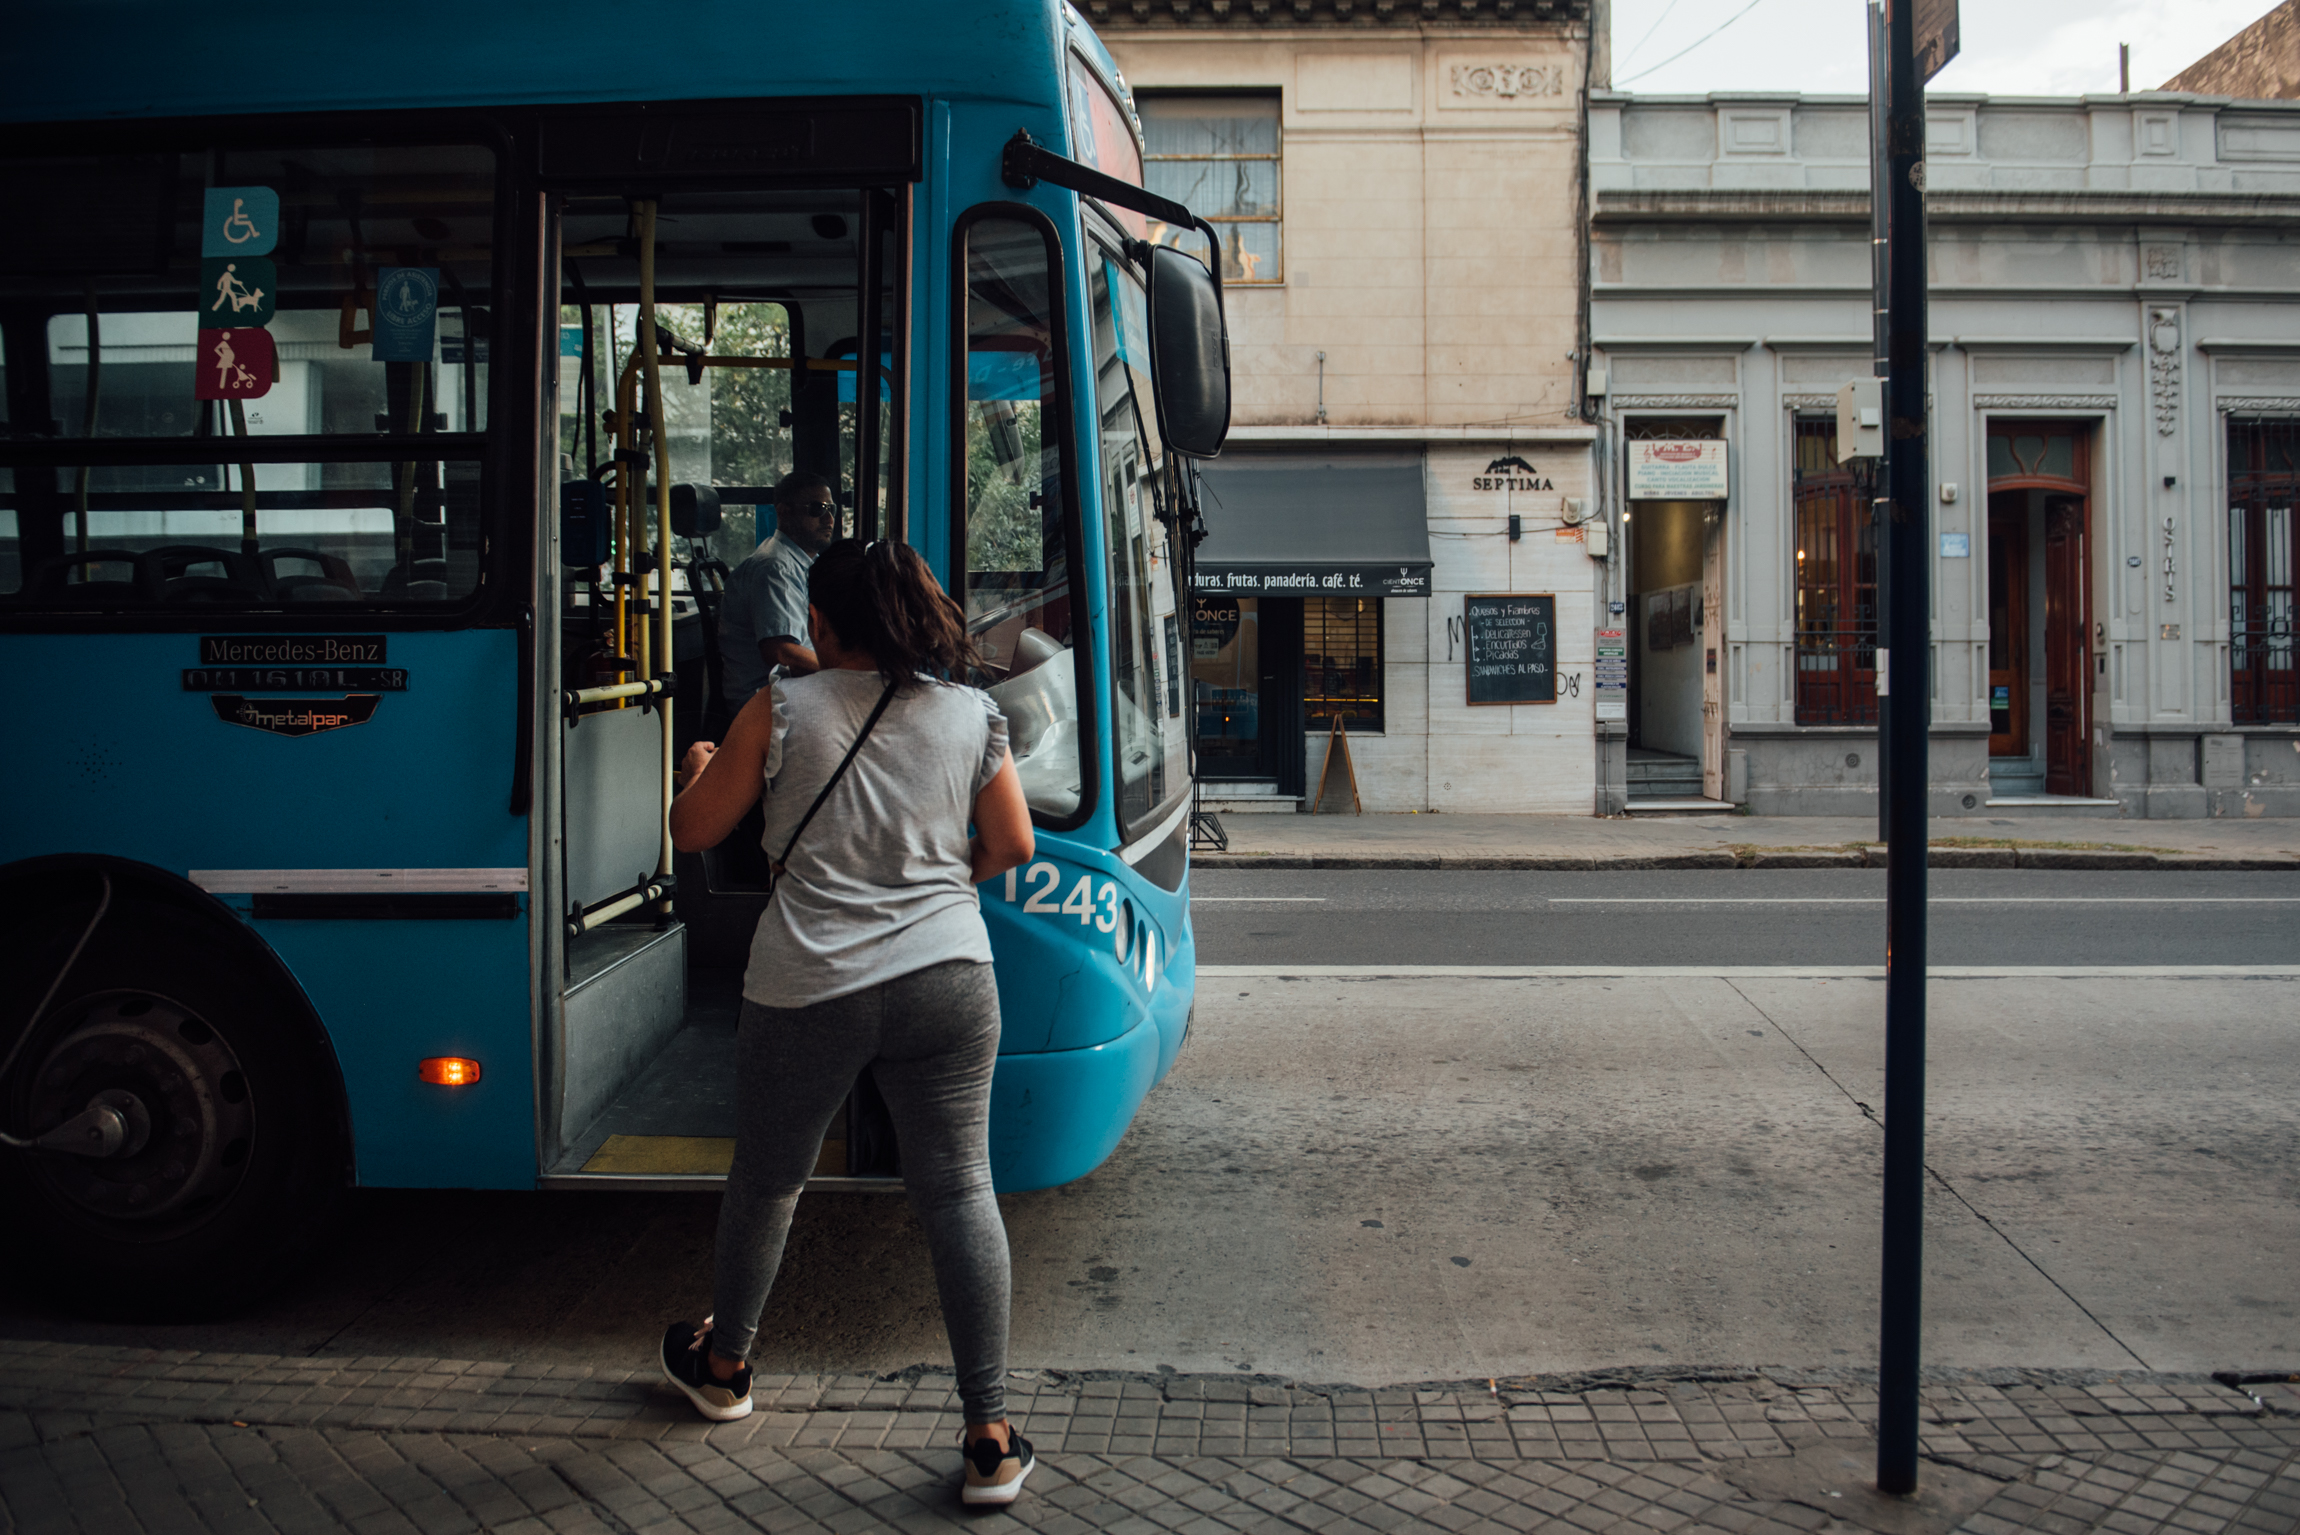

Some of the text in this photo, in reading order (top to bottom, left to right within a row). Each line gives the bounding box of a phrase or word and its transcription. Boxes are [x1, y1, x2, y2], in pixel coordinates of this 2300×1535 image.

[1473, 477, 1554, 491] SEPTIMA
[2162, 516, 2176, 603] OSIRIS
[1227, 572, 1261, 589] frutas.
[1264, 572, 1319, 590] panadería.
[1322, 573, 1346, 589] café.
[1349, 573, 1364, 588] té.
[1195, 610, 1237, 622] ONCE
[1471, 604, 1541, 617] Quesos y Fiambres
[208, 639, 379, 662] Mercedes-Benz
[256, 709, 349, 730] metalpar
[1005, 861, 1118, 933] 1243
